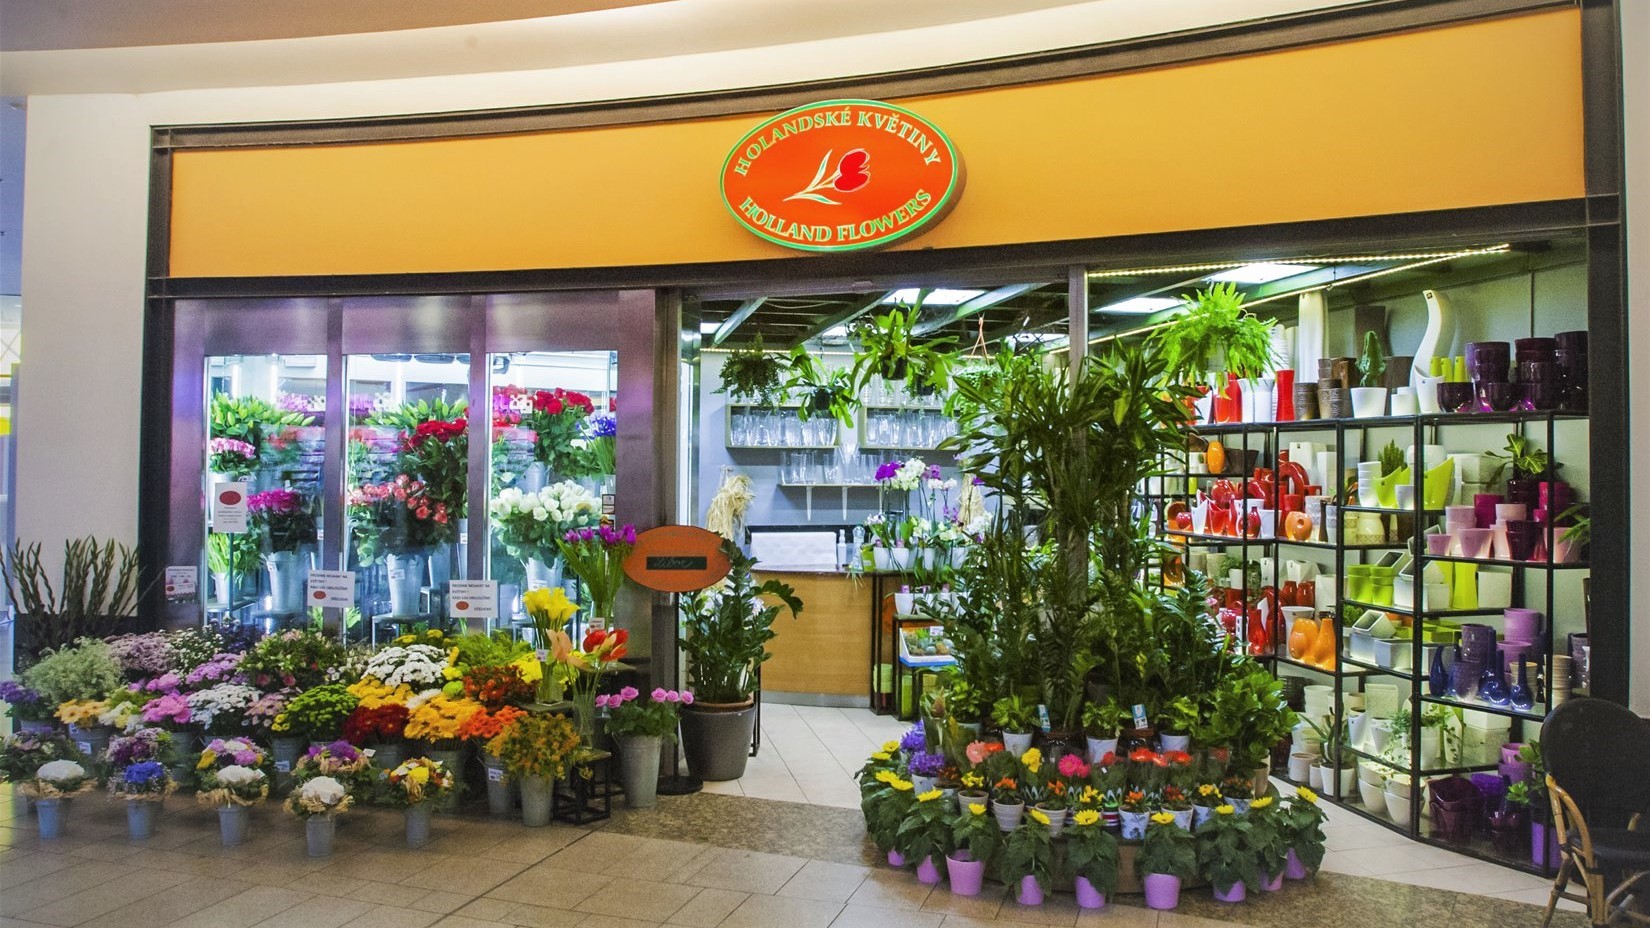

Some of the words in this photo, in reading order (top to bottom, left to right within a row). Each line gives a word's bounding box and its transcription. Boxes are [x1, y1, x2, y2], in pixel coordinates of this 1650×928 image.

[734, 107, 852, 177] HOLANDSKÉ
[857, 111, 942, 166] KVĚTINY
[738, 196, 832, 242] HOLLAND
[837, 189, 932, 242] FLOWERS
